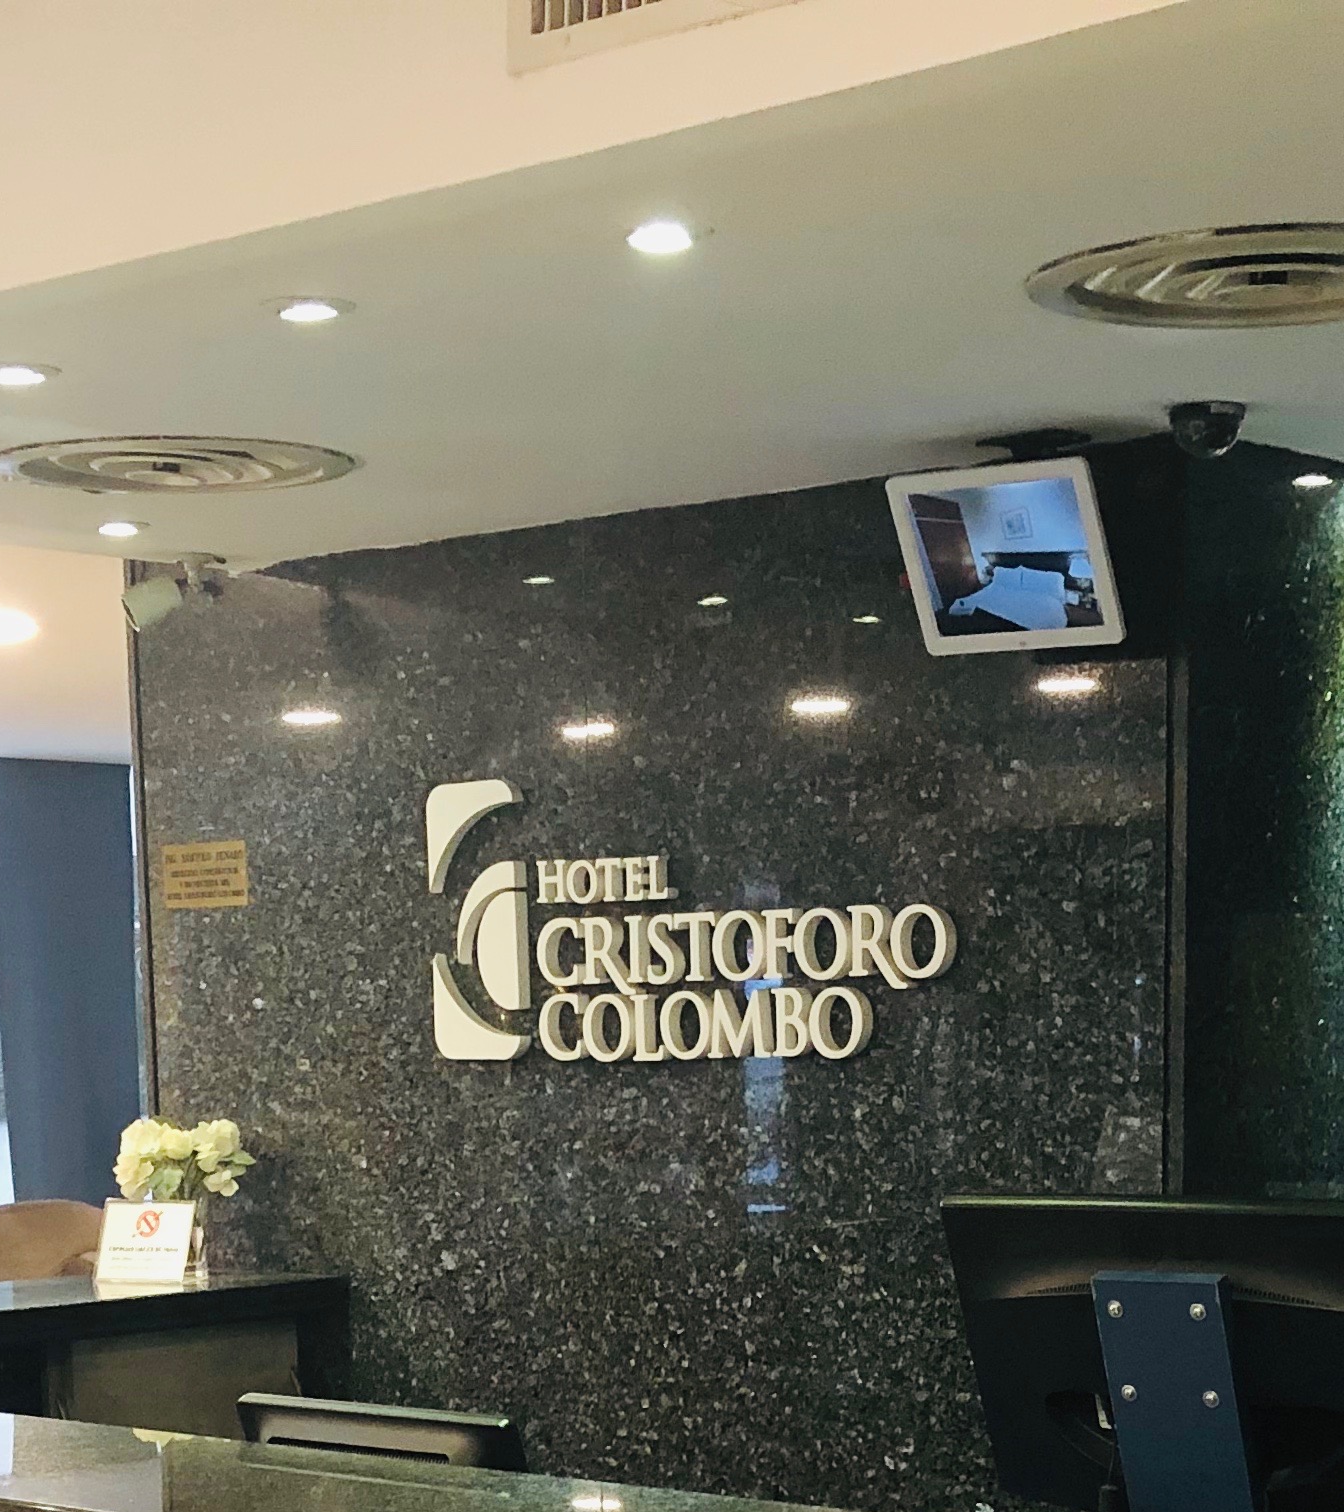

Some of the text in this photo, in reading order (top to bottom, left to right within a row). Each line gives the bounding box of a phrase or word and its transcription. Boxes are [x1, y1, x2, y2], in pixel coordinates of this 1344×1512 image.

[536, 855, 676, 904] HOTEL
[536, 902, 956, 993] CRISTOFORO
[538, 986, 872, 1063] COLOMBO
